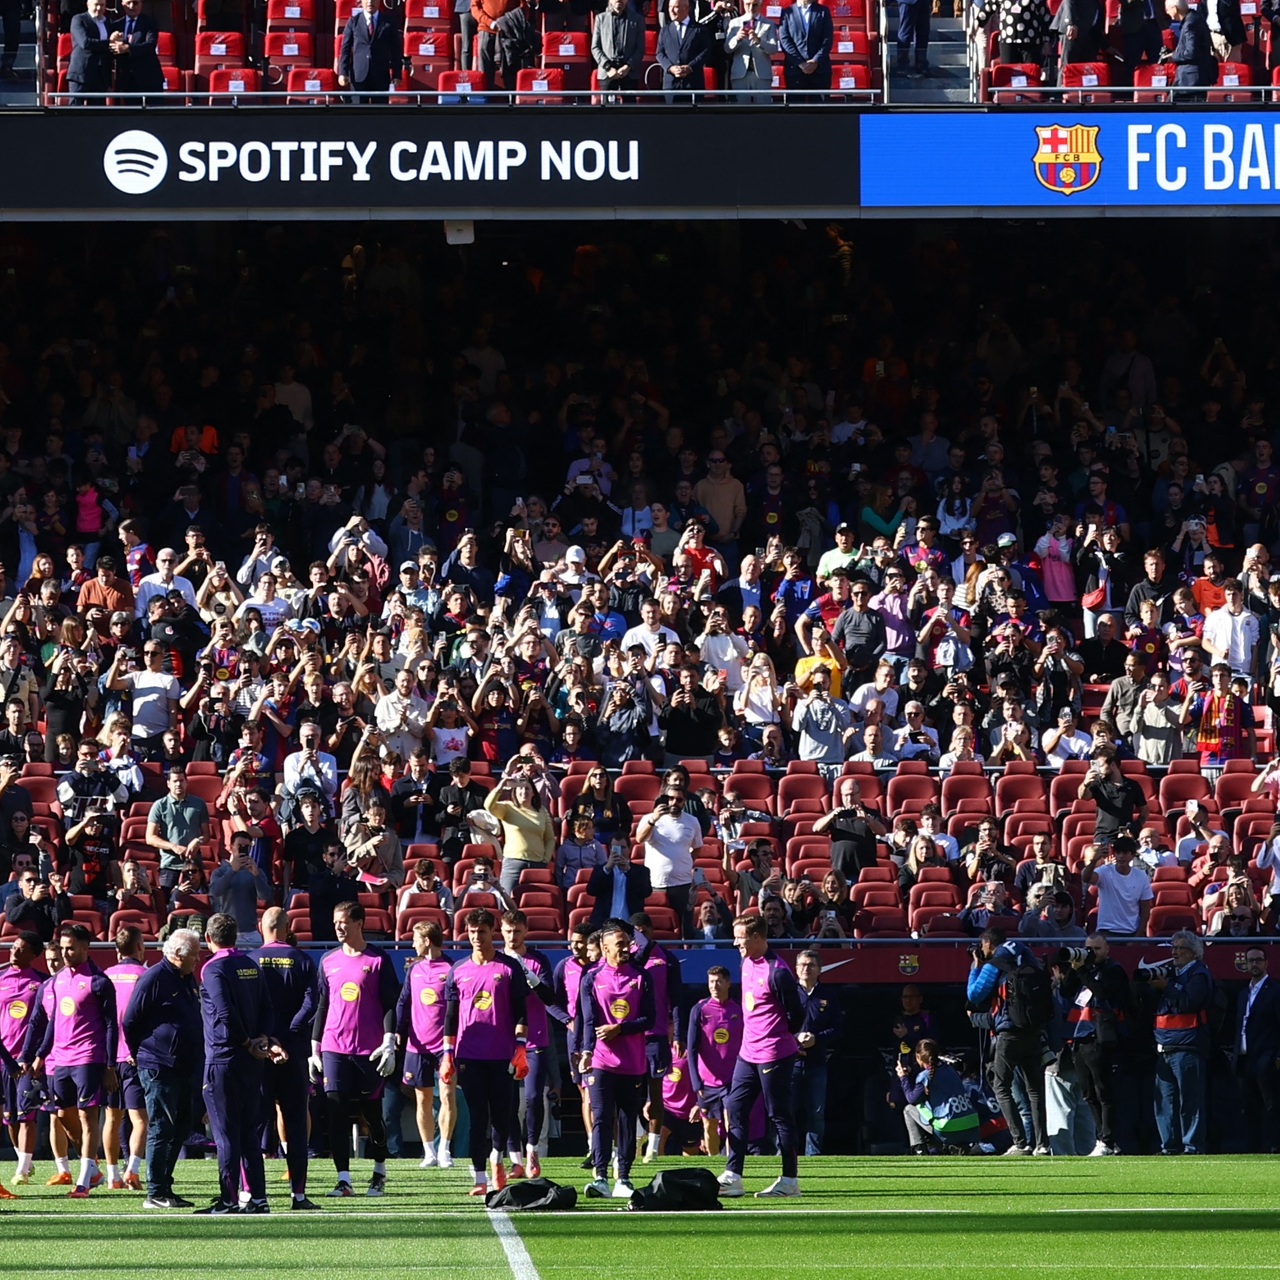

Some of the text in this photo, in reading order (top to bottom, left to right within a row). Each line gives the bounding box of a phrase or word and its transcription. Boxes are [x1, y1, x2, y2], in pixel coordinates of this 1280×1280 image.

[178, 139, 639, 182] SPOTIFY CAMP NOU
[1055, 153, 1081, 162] FCB
[1127, 123, 1187, 191] FC
[271, 957, 295, 965] CONGO
